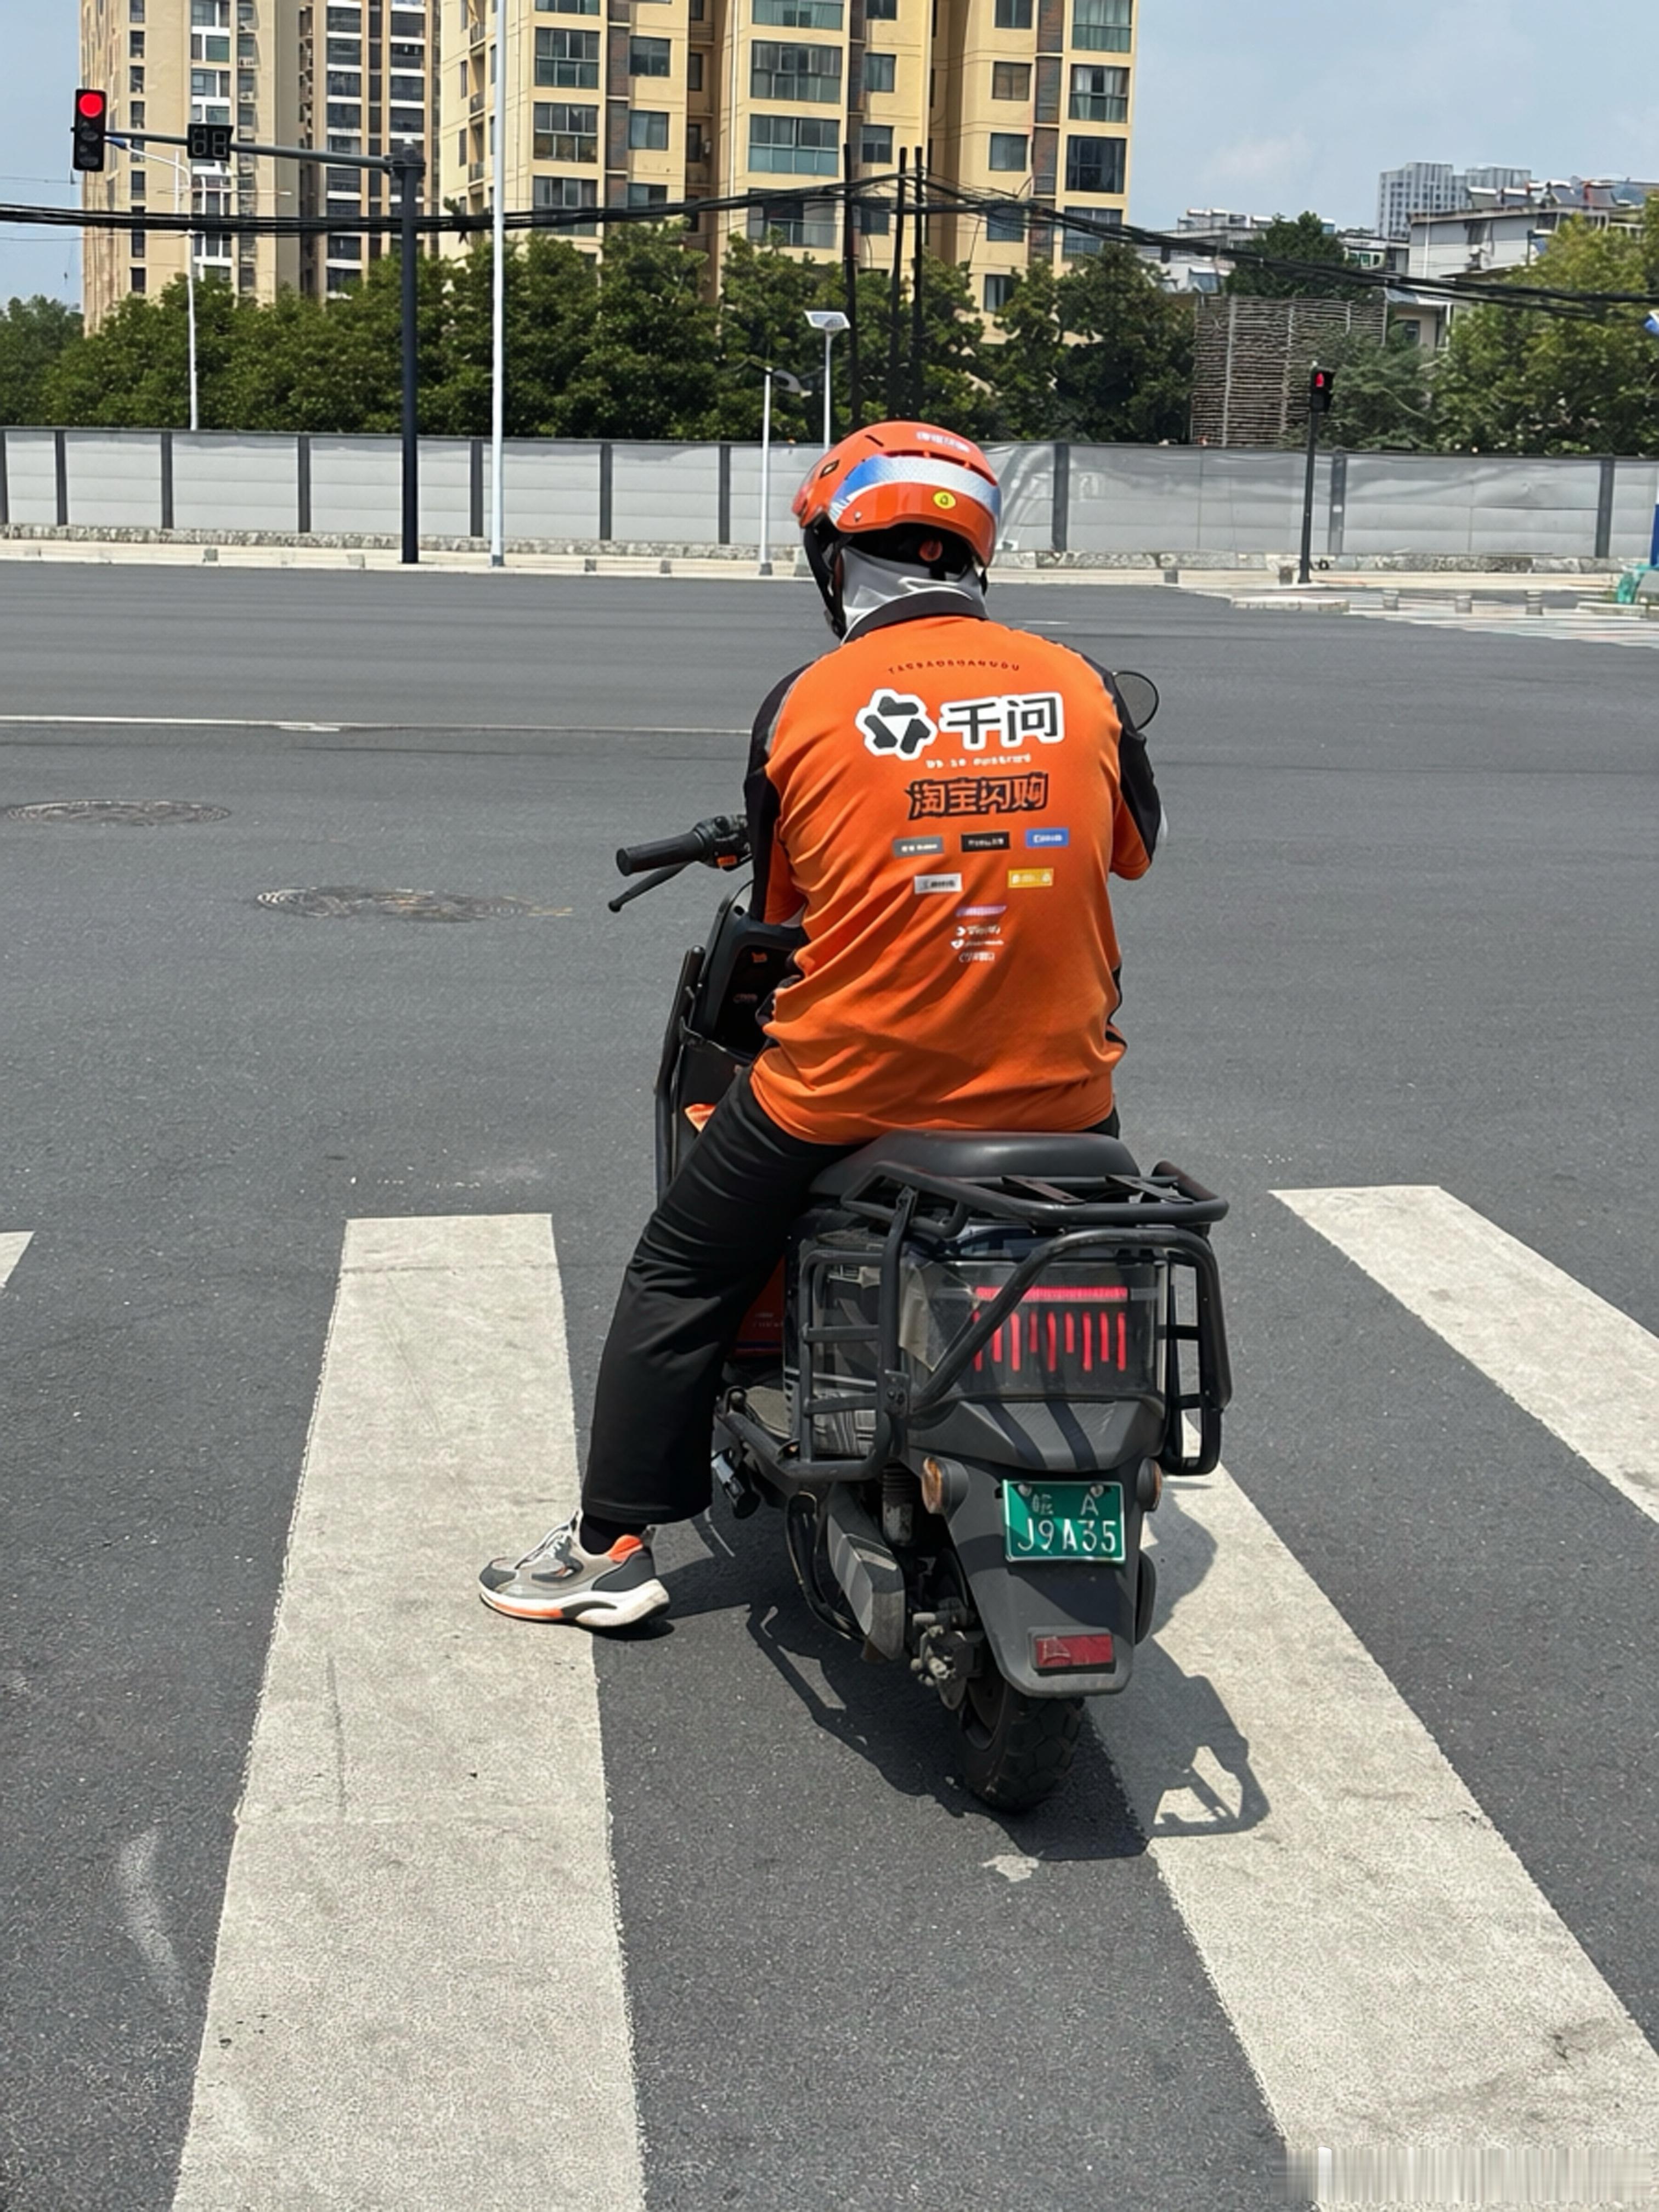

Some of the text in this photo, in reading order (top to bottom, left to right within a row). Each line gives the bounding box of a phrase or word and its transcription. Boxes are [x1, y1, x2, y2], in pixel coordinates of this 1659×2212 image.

[945, 695, 1060, 746] 千问
[906, 772, 1048, 819] 淘宝闪购
[1080, 1493, 1099, 1516] A
[1017, 1518, 1116, 1553] J9A35
